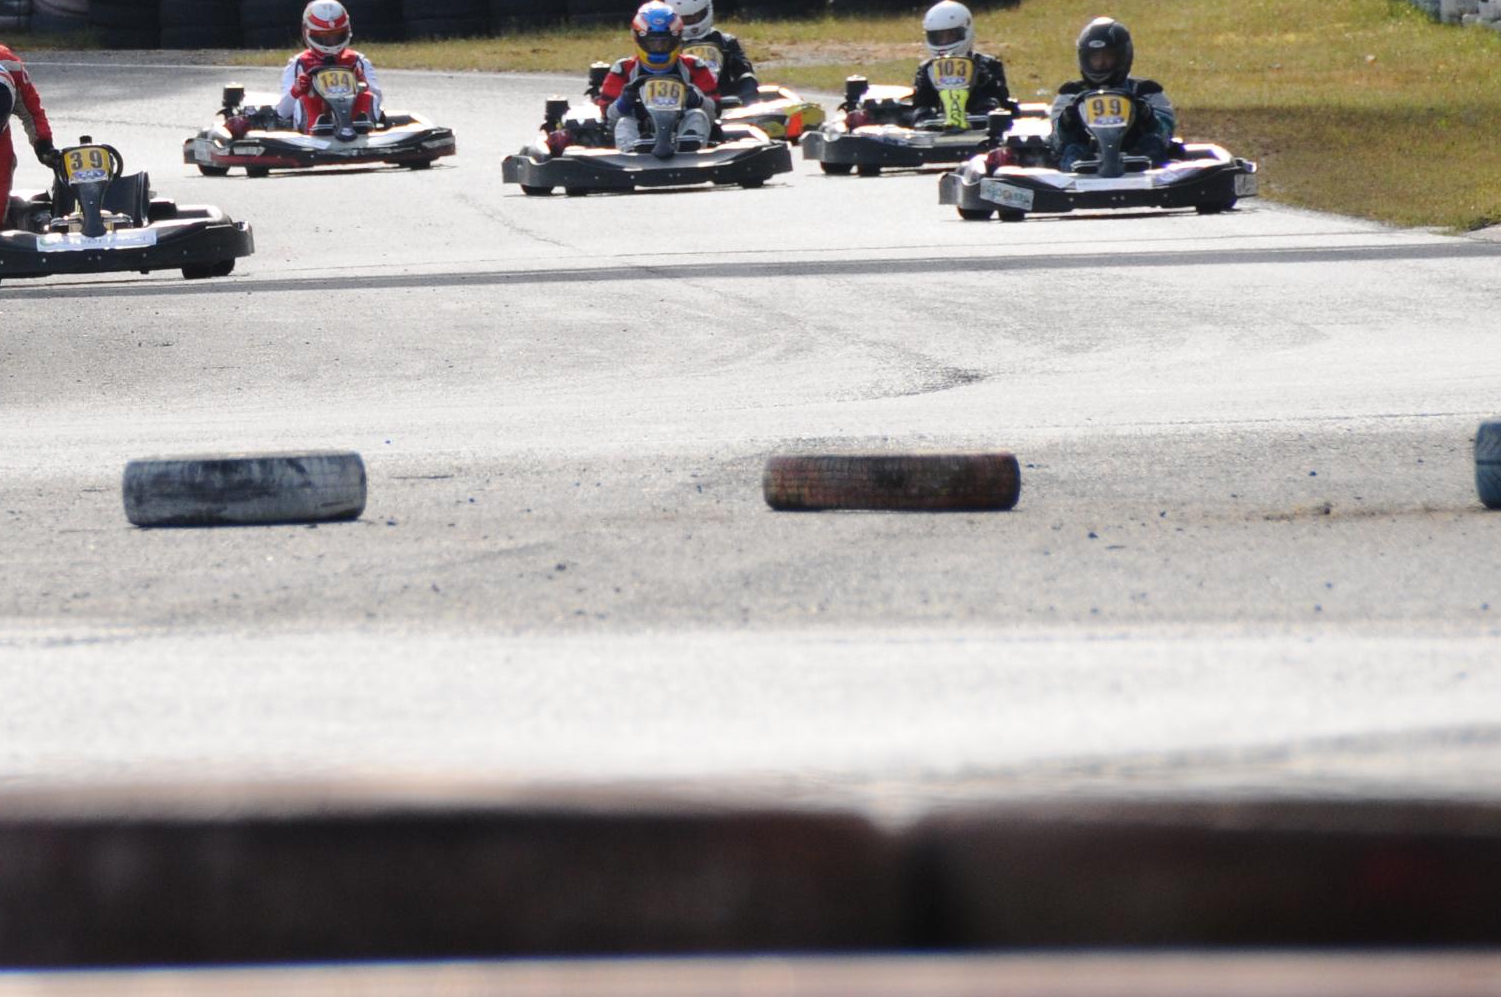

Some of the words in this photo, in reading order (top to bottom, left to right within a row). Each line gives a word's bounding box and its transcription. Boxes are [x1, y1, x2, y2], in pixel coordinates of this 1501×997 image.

[937, 60, 966, 76] 103
[1092, 98, 1121, 116] 99
[70, 150, 103, 171] 39
